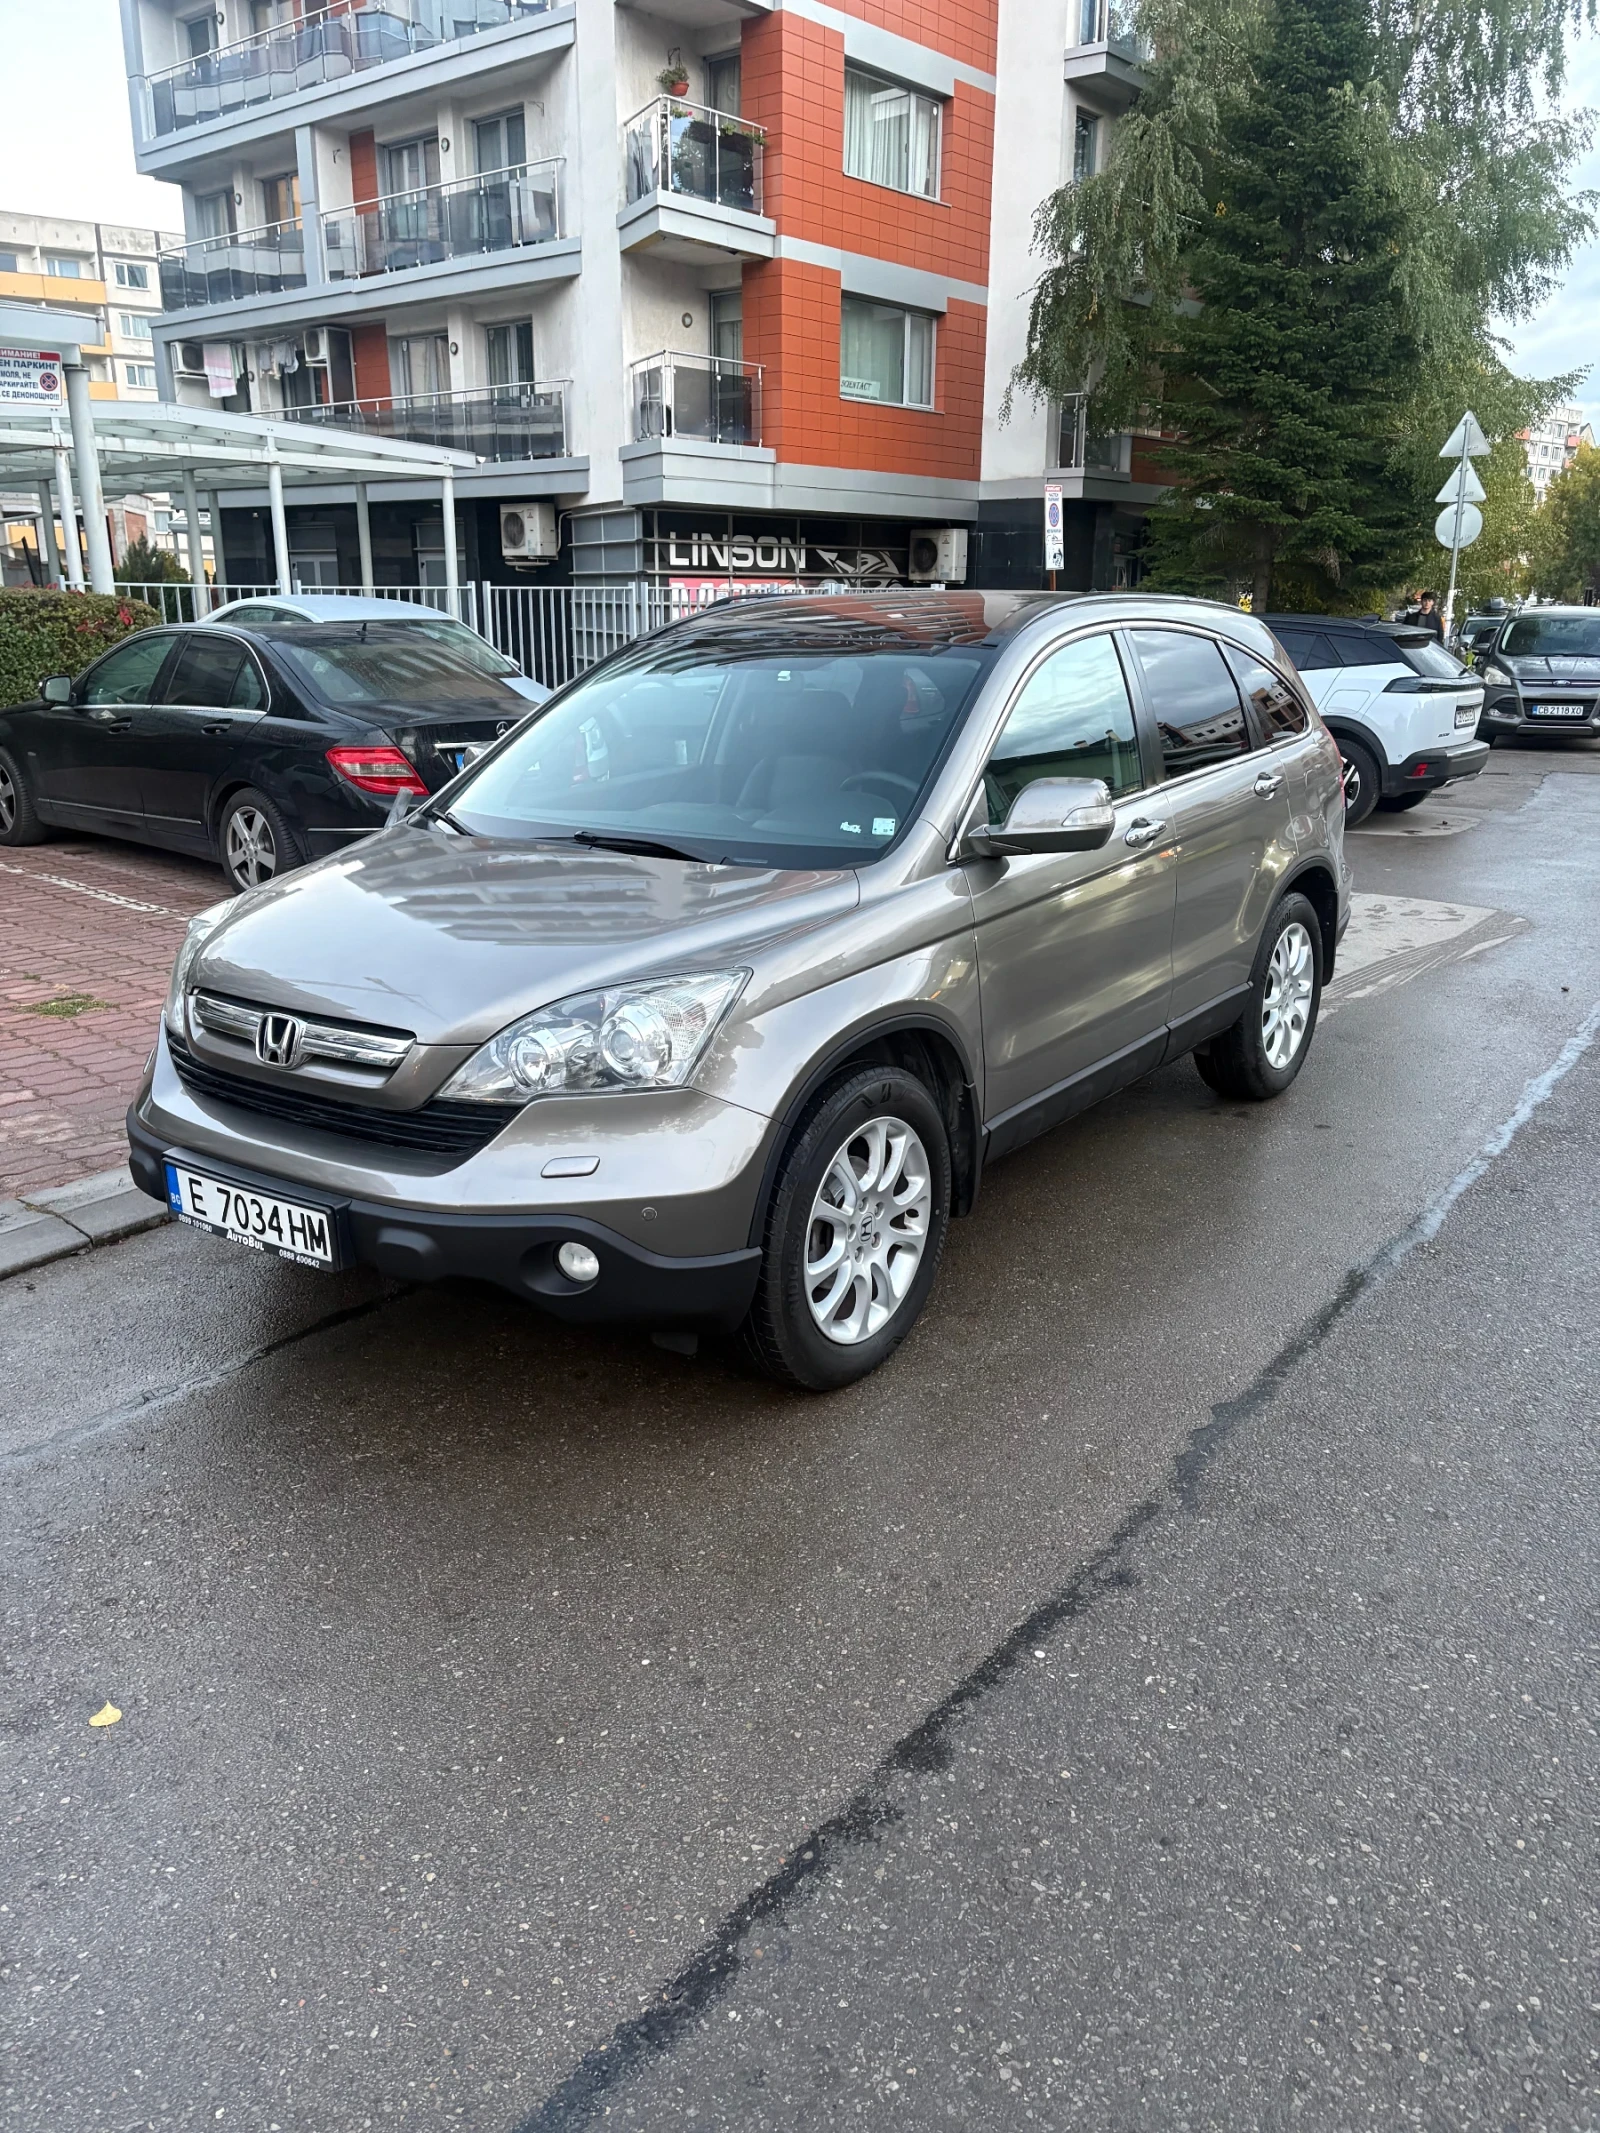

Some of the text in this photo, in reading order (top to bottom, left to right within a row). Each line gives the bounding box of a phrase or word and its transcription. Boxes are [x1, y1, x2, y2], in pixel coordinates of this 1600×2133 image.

[0, 349, 40, 359] ИМАНИЕ!
[13, 360, 57, 370] ПАРКИНГ
[22, 371, 32, 380] НЕ
[669, 531, 807, 569] LINSON
[1550, 706, 1570, 715] 2118
[170, 1192, 181, 1205] BG
[188, 1177, 208, 1217] E
[278, 1248, 295, 1261] 0888
